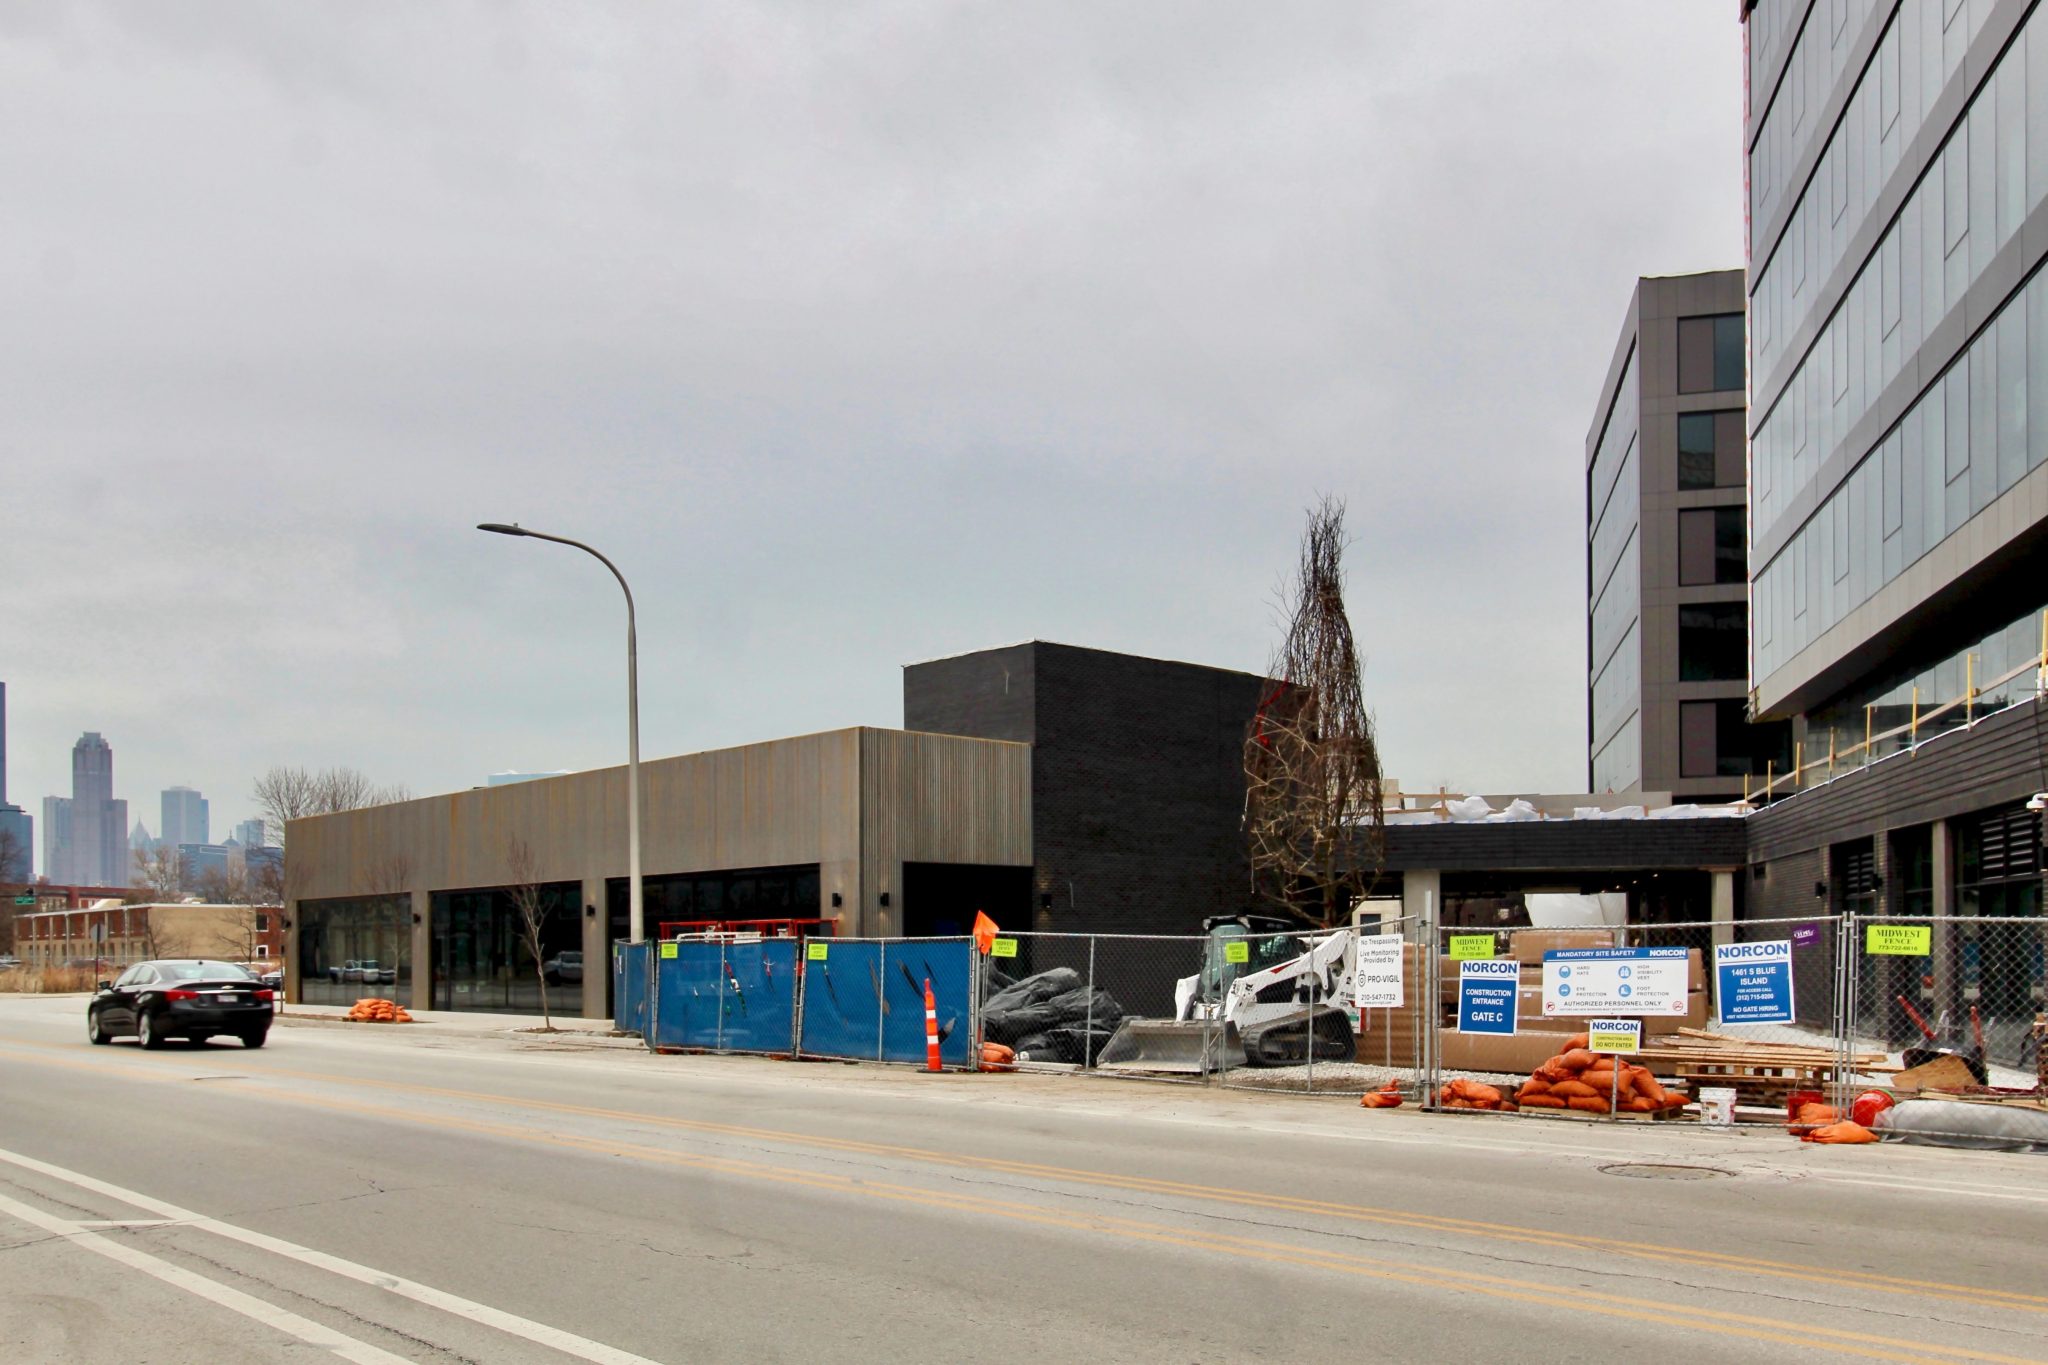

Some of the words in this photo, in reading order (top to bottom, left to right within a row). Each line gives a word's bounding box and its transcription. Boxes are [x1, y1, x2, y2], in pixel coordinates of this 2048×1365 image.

[1876, 929, 1922, 938] MIDWEST
[1649, 949, 1686, 957] NORCON
[1718, 943, 1788, 959] NORCON
[1462, 962, 1517, 974] NORCON
[1731, 968, 1747, 976] 1461
[1756, 967, 1776, 975] BLUE
[1368, 975, 1399, 983] PRO-VIGIL
[1740, 977, 1768, 985] ISLAND
[1465, 989, 1512, 997] CONSTRUCTION
[1472, 998, 1504, 1006] ENTRANCE
[1471, 1012, 1495, 1022] GATE
[1496, 1013, 1503, 1022] C
[1592, 1022, 1638, 1031] NORCON
